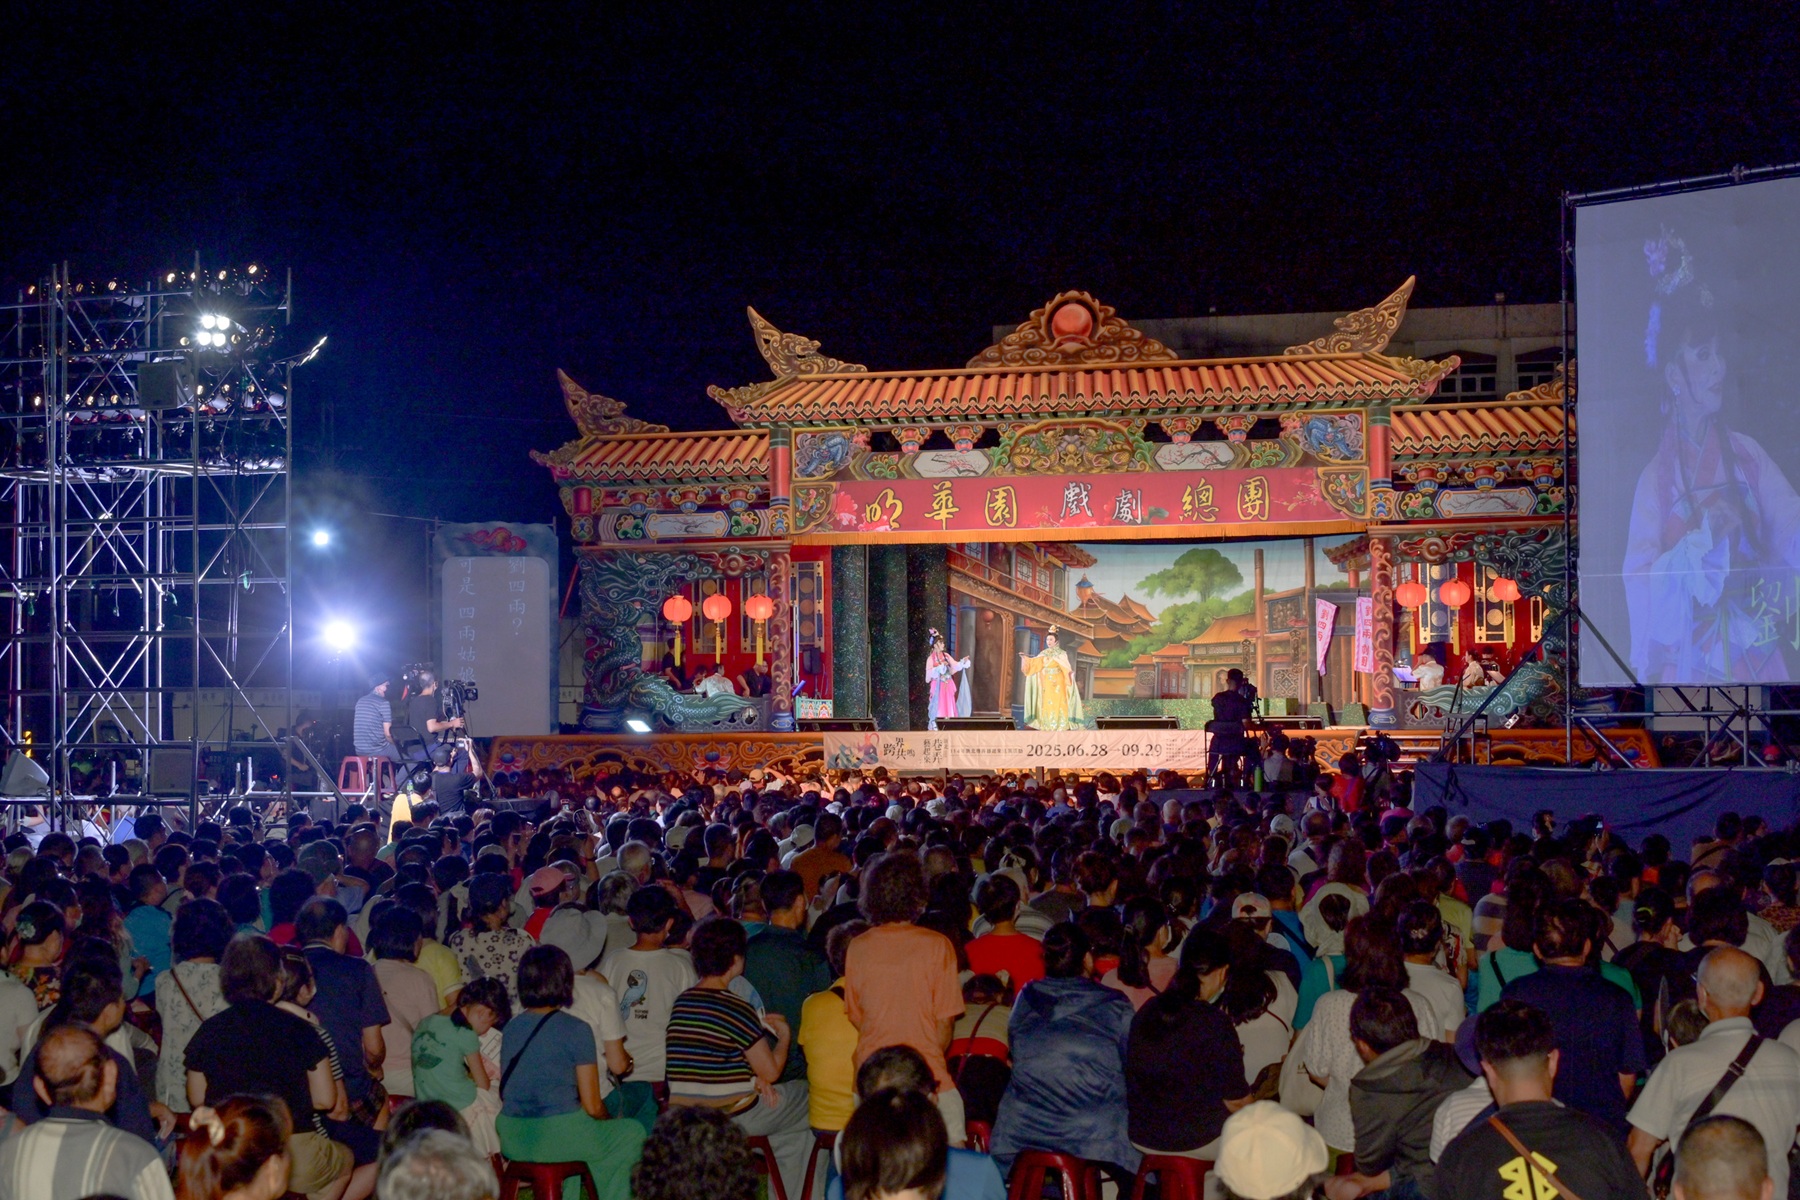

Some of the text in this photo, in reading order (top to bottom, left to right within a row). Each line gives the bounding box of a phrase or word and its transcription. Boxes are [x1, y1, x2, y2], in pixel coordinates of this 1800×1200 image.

[1750, 576, 1800, 651] 劉
[1026, 744, 1108, 757] 2025.06.28
[1121, 743, 1163, 757] 09.29
